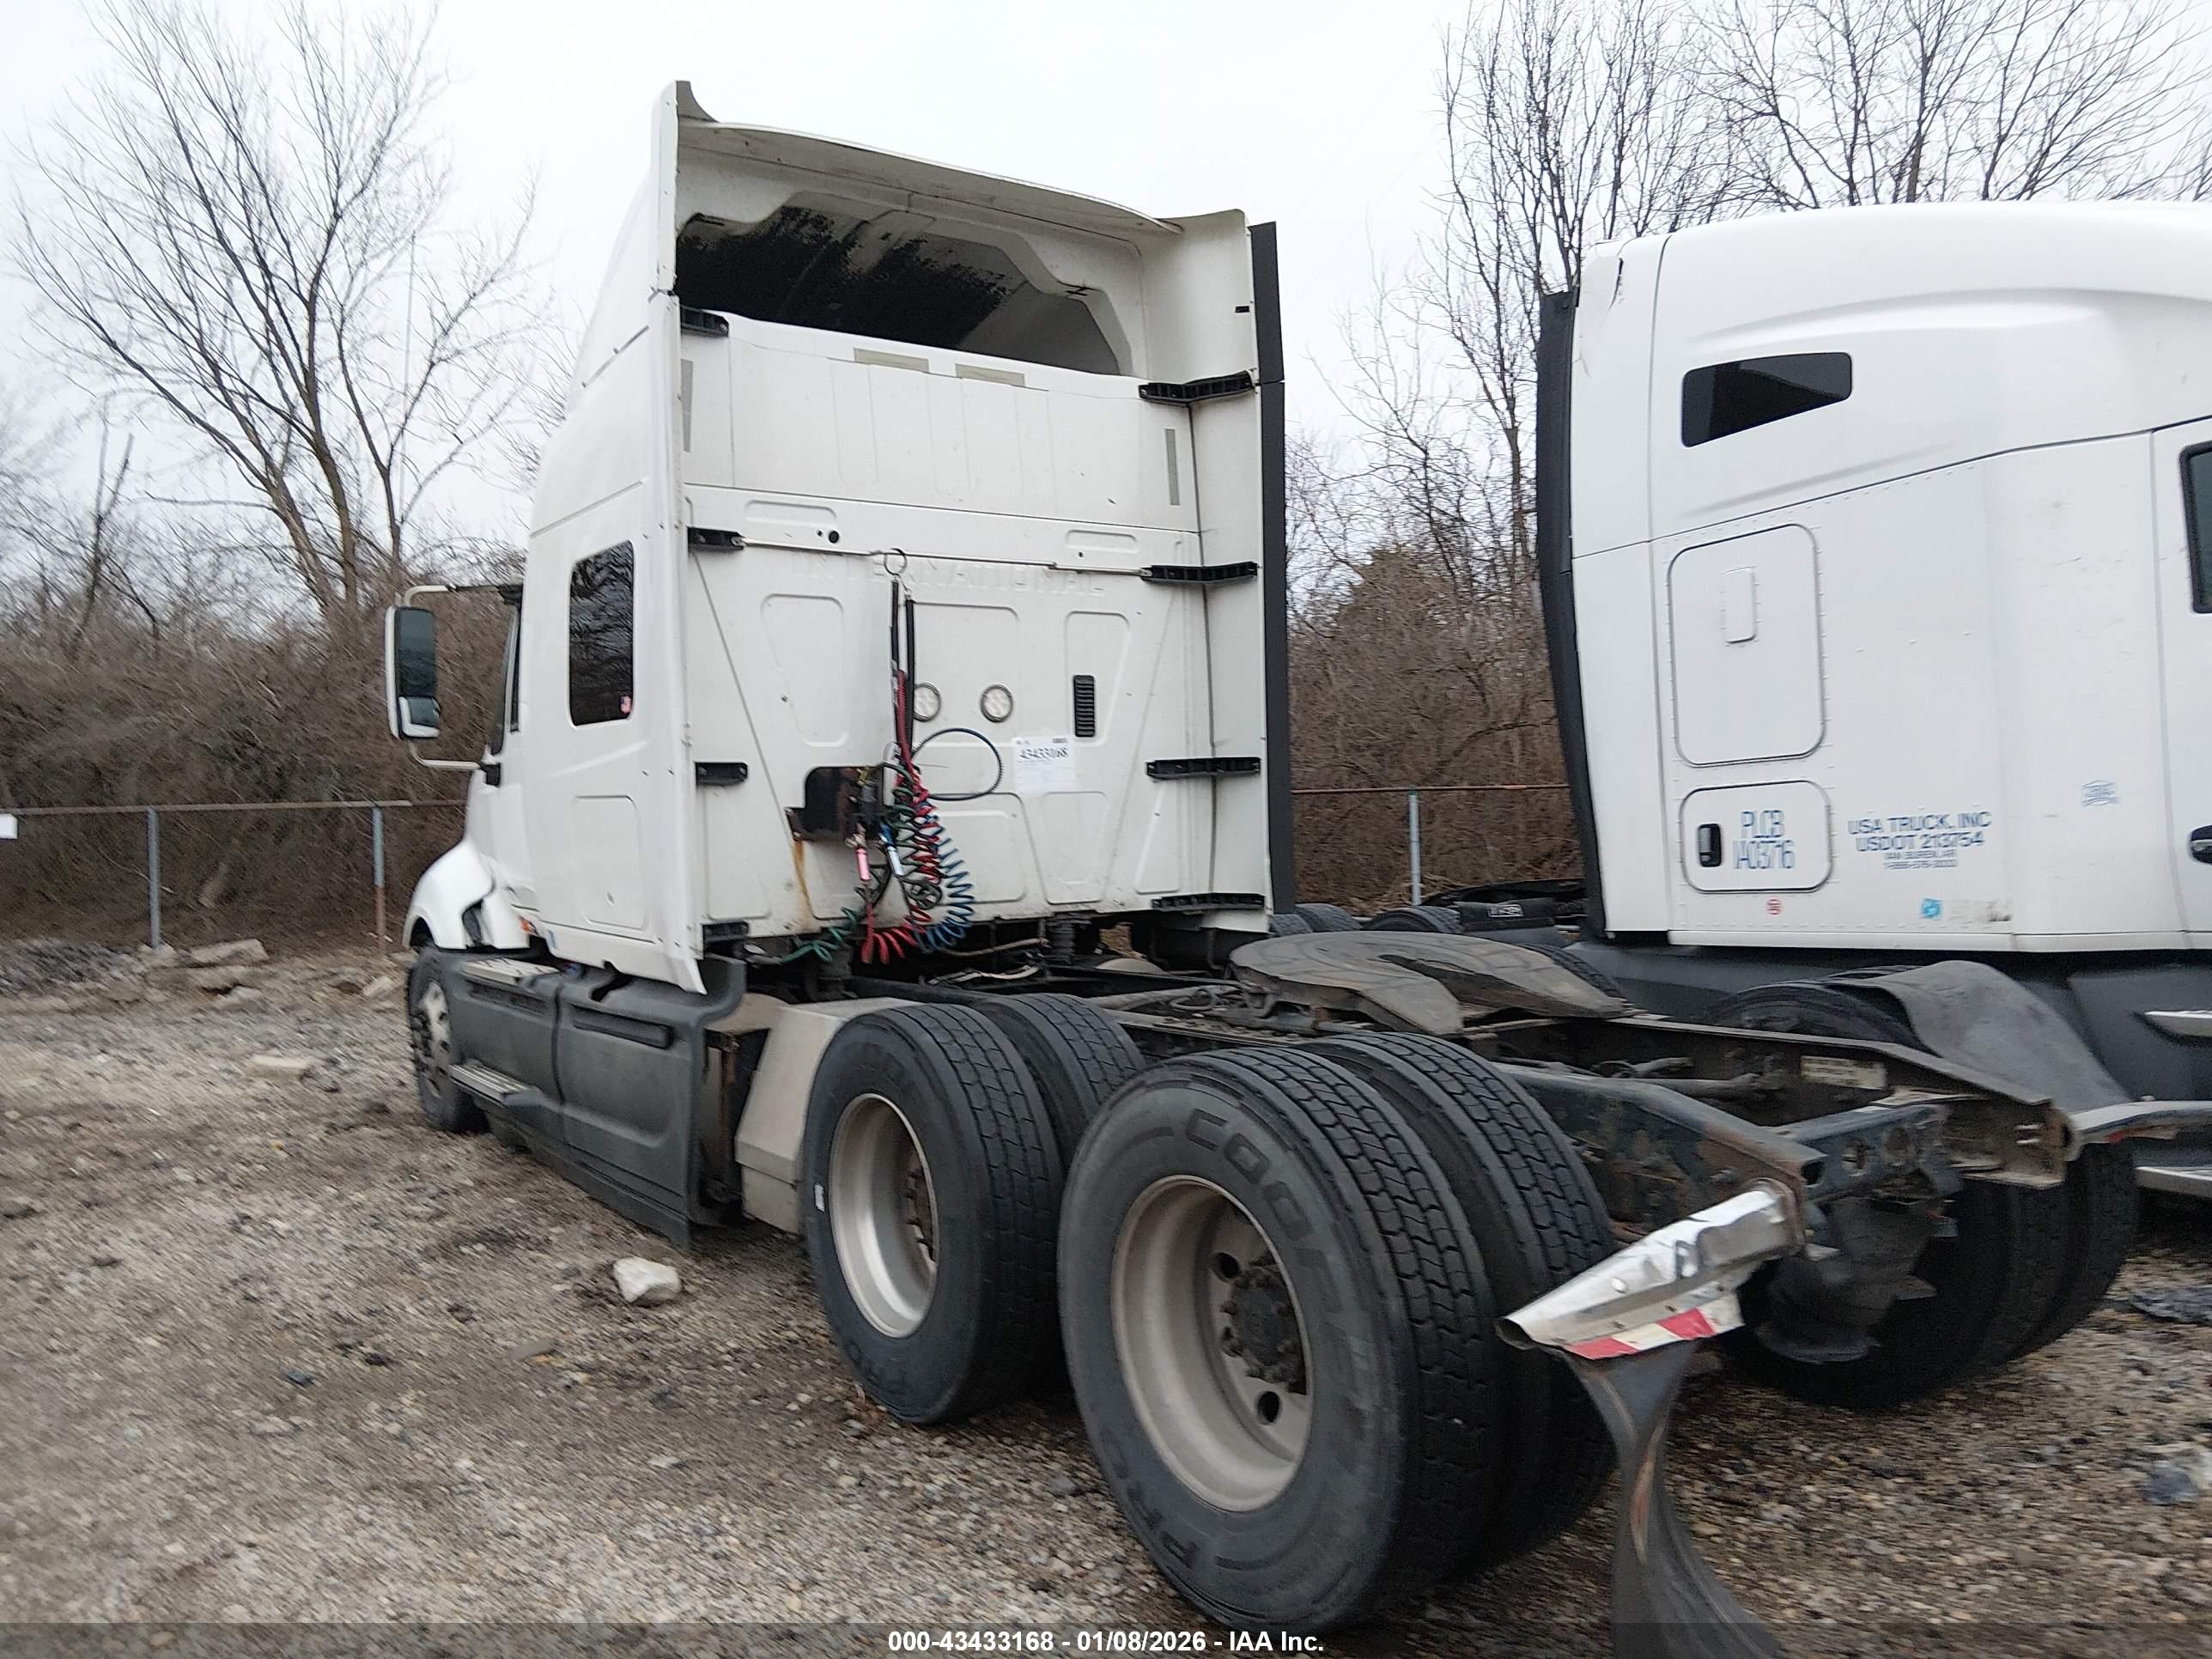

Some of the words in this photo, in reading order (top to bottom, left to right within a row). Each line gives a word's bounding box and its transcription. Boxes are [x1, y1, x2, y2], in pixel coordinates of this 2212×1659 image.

[1740, 809, 1785, 838] PLCB
[1848, 818, 1883, 835] USA
[1856, 835, 1917, 853] USDOT
[1920, 830, 1985, 849] 213754
